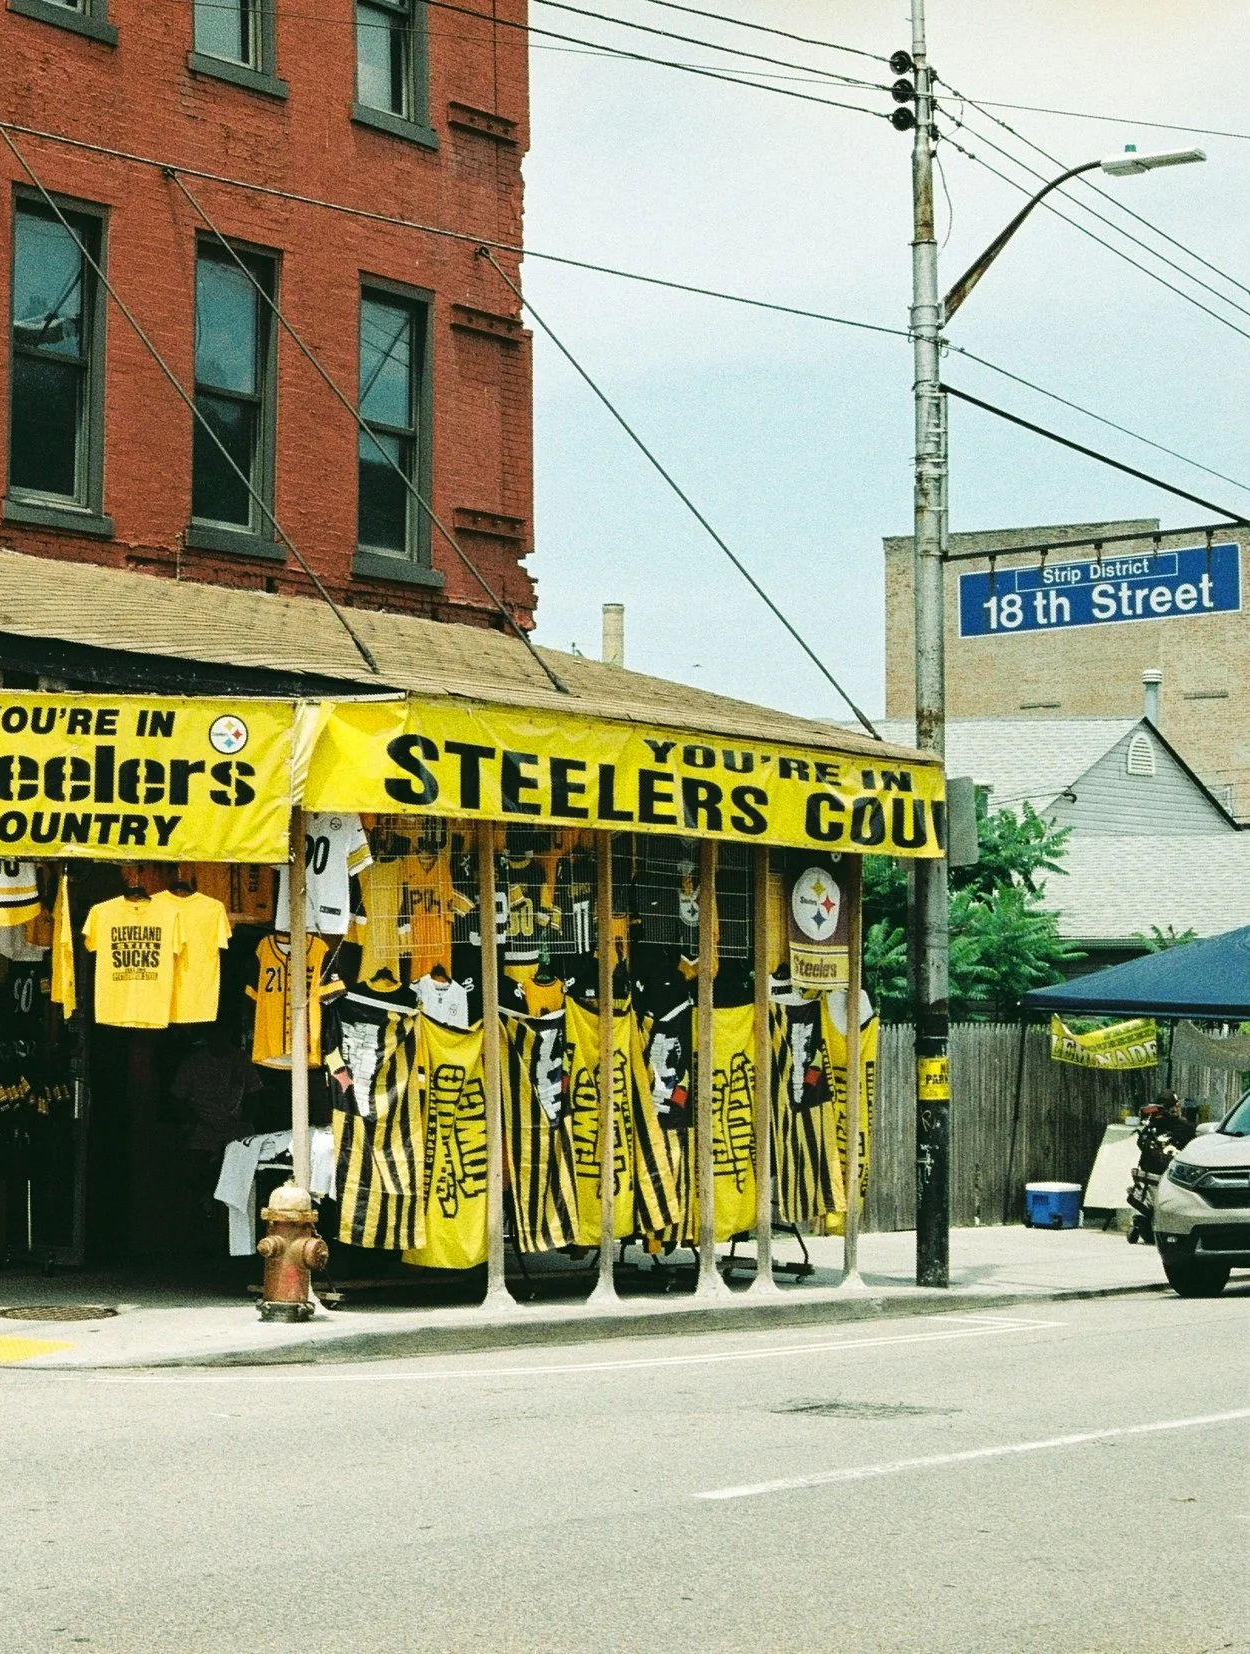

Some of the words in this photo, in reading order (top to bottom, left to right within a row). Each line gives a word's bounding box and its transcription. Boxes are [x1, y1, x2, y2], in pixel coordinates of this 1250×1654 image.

[1043, 569, 1081, 585] Strip
[1089, 560, 1149, 580] District
[1092, 574, 1214, 619] Street
[137, 709, 176, 738] IN
[644, 739, 841, 786] YOU'RE
[862, 769, 913, 792] IN
[385, 734, 769, 835] STEELERS
[111, 925, 162, 942] CLEVELAND
[112, 949, 160, 968] SUCKS
[265, 966, 282, 992] 21
[1051, 1034, 1159, 1067] LEMNADE
